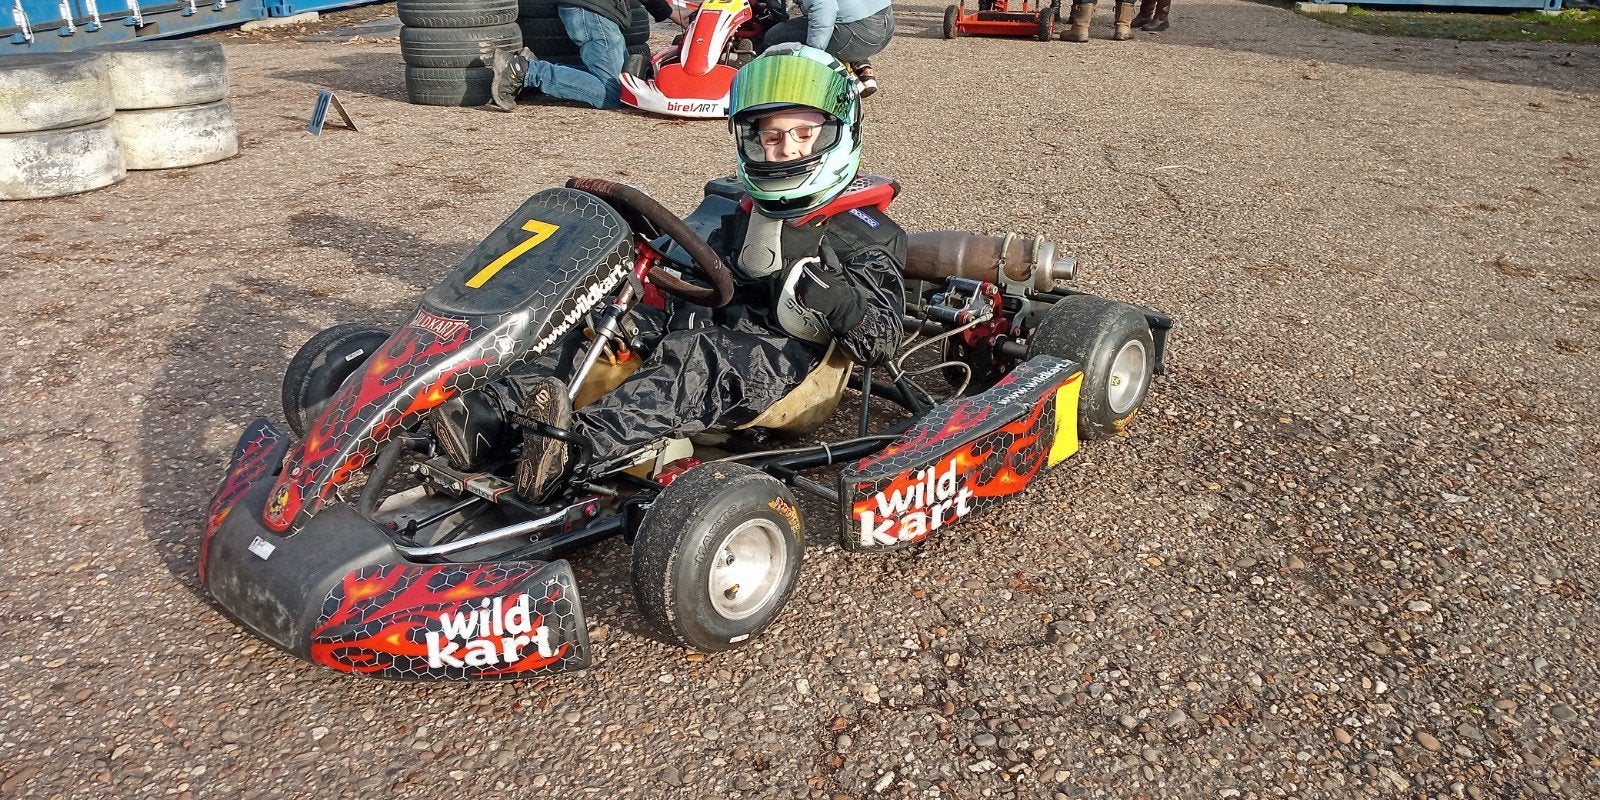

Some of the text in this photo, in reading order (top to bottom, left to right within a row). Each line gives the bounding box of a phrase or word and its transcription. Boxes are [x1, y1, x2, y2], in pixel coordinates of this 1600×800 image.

[465, 219, 560, 289] 7
[860, 486, 974, 546] kart
[875, 458, 957, 518] wild
[425, 625, 560, 668] kart
[439, 594, 531, 640] wild
